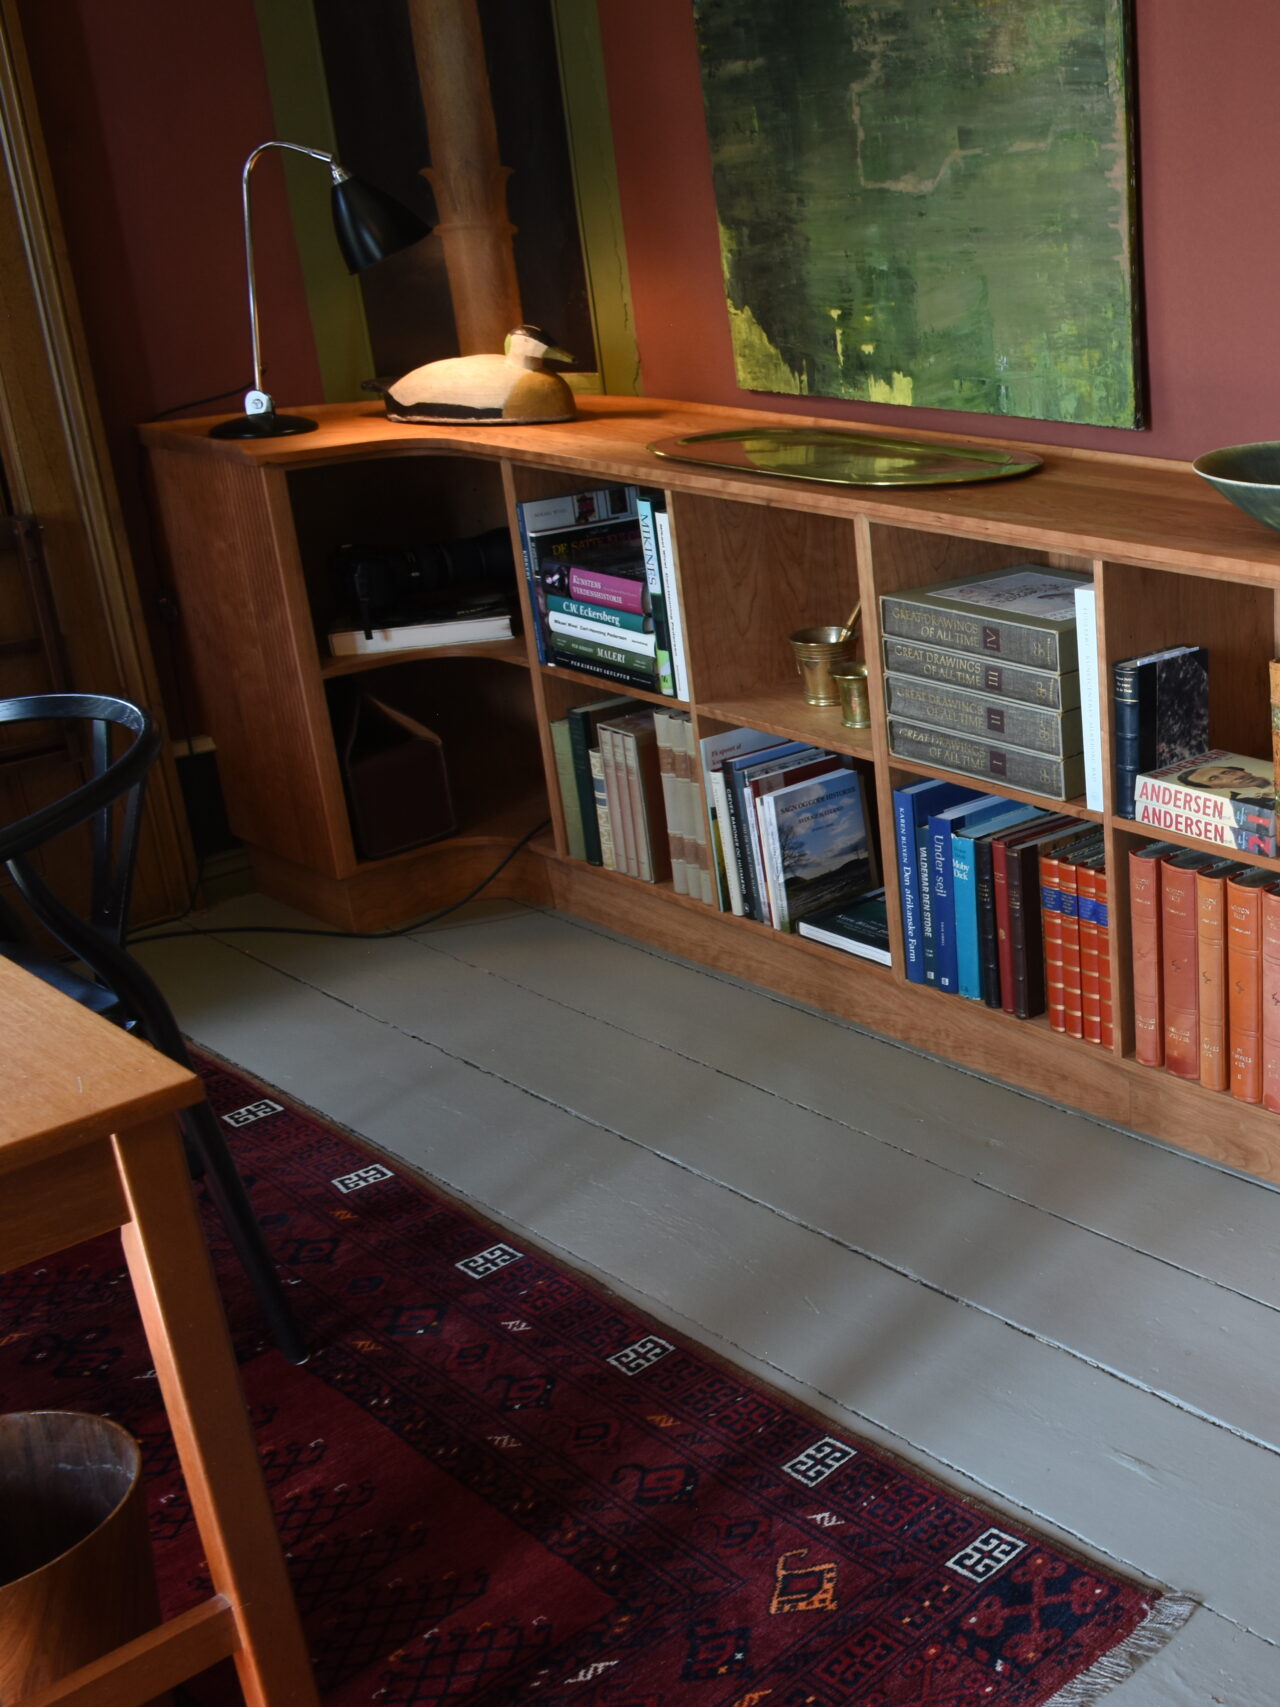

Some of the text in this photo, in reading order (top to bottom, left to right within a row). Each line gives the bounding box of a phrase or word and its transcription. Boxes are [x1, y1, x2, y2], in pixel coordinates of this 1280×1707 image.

[640, 514, 657, 586] MIKINES
[562, 601, 621, 626] C.W. Eckersberg
[892, 607, 979, 634] GREAT DRAWINGS
[920, 626, 980, 648] OF ALL TIME
[597, 647, 626, 664] MALERI
[895, 645, 981, 673] GREAT DRAWINGS
[924, 664, 982, 686] OF ALL TIME
[899, 728, 985, 758] GREAT DRAWINGS
[929, 747, 985, 769] OF ALL TIME
[1147, 750, 1230, 779] ANDERSEN
[1140, 782, 1224, 820] ANDERSEN
[1141, 805, 1225, 843] ANDERSEN
[1247, 814, 1271, 827] 1
[901, 834, 909, 864] BLIXEN
[1247, 836, 1272, 855] 2
[903, 866, 911, 886] Den
[934, 835, 947, 897] Under sejl
[953, 859, 970, 873] Moby
[953, 868, 968, 880] Dick
[919, 847, 933, 938] VALDEMAR DEN STORE
[902, 888, 914, 937] afrikanske
[909, 937, 917, 962] Farm
